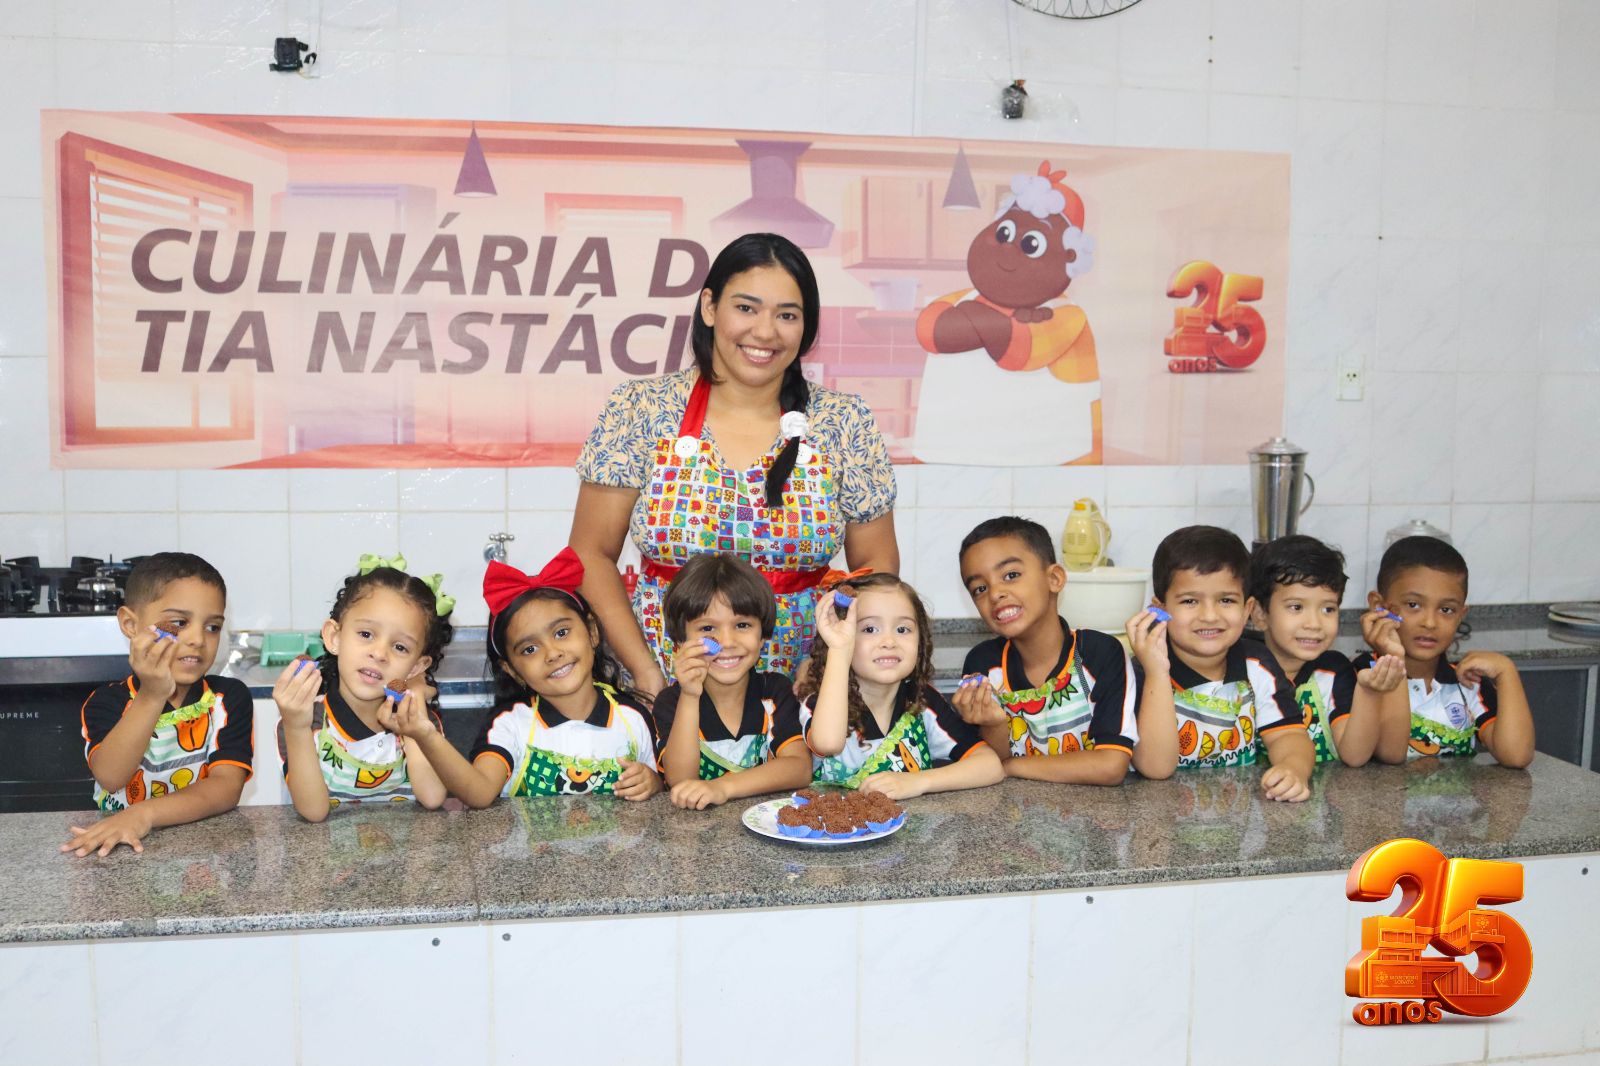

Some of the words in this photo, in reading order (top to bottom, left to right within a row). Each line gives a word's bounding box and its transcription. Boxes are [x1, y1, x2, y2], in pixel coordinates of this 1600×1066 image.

[131, 212, 617, 297] CULINÁRIA
[648, 238, 710, 298] D
[135, 309, 274, 374] TIA
[306, 292, 697, 376] NASTÁCI
[1164, 259, 1267, 369] 25
[1168, 358, 1217, 374] anos
[0, 711, 40, 720] UPREME
